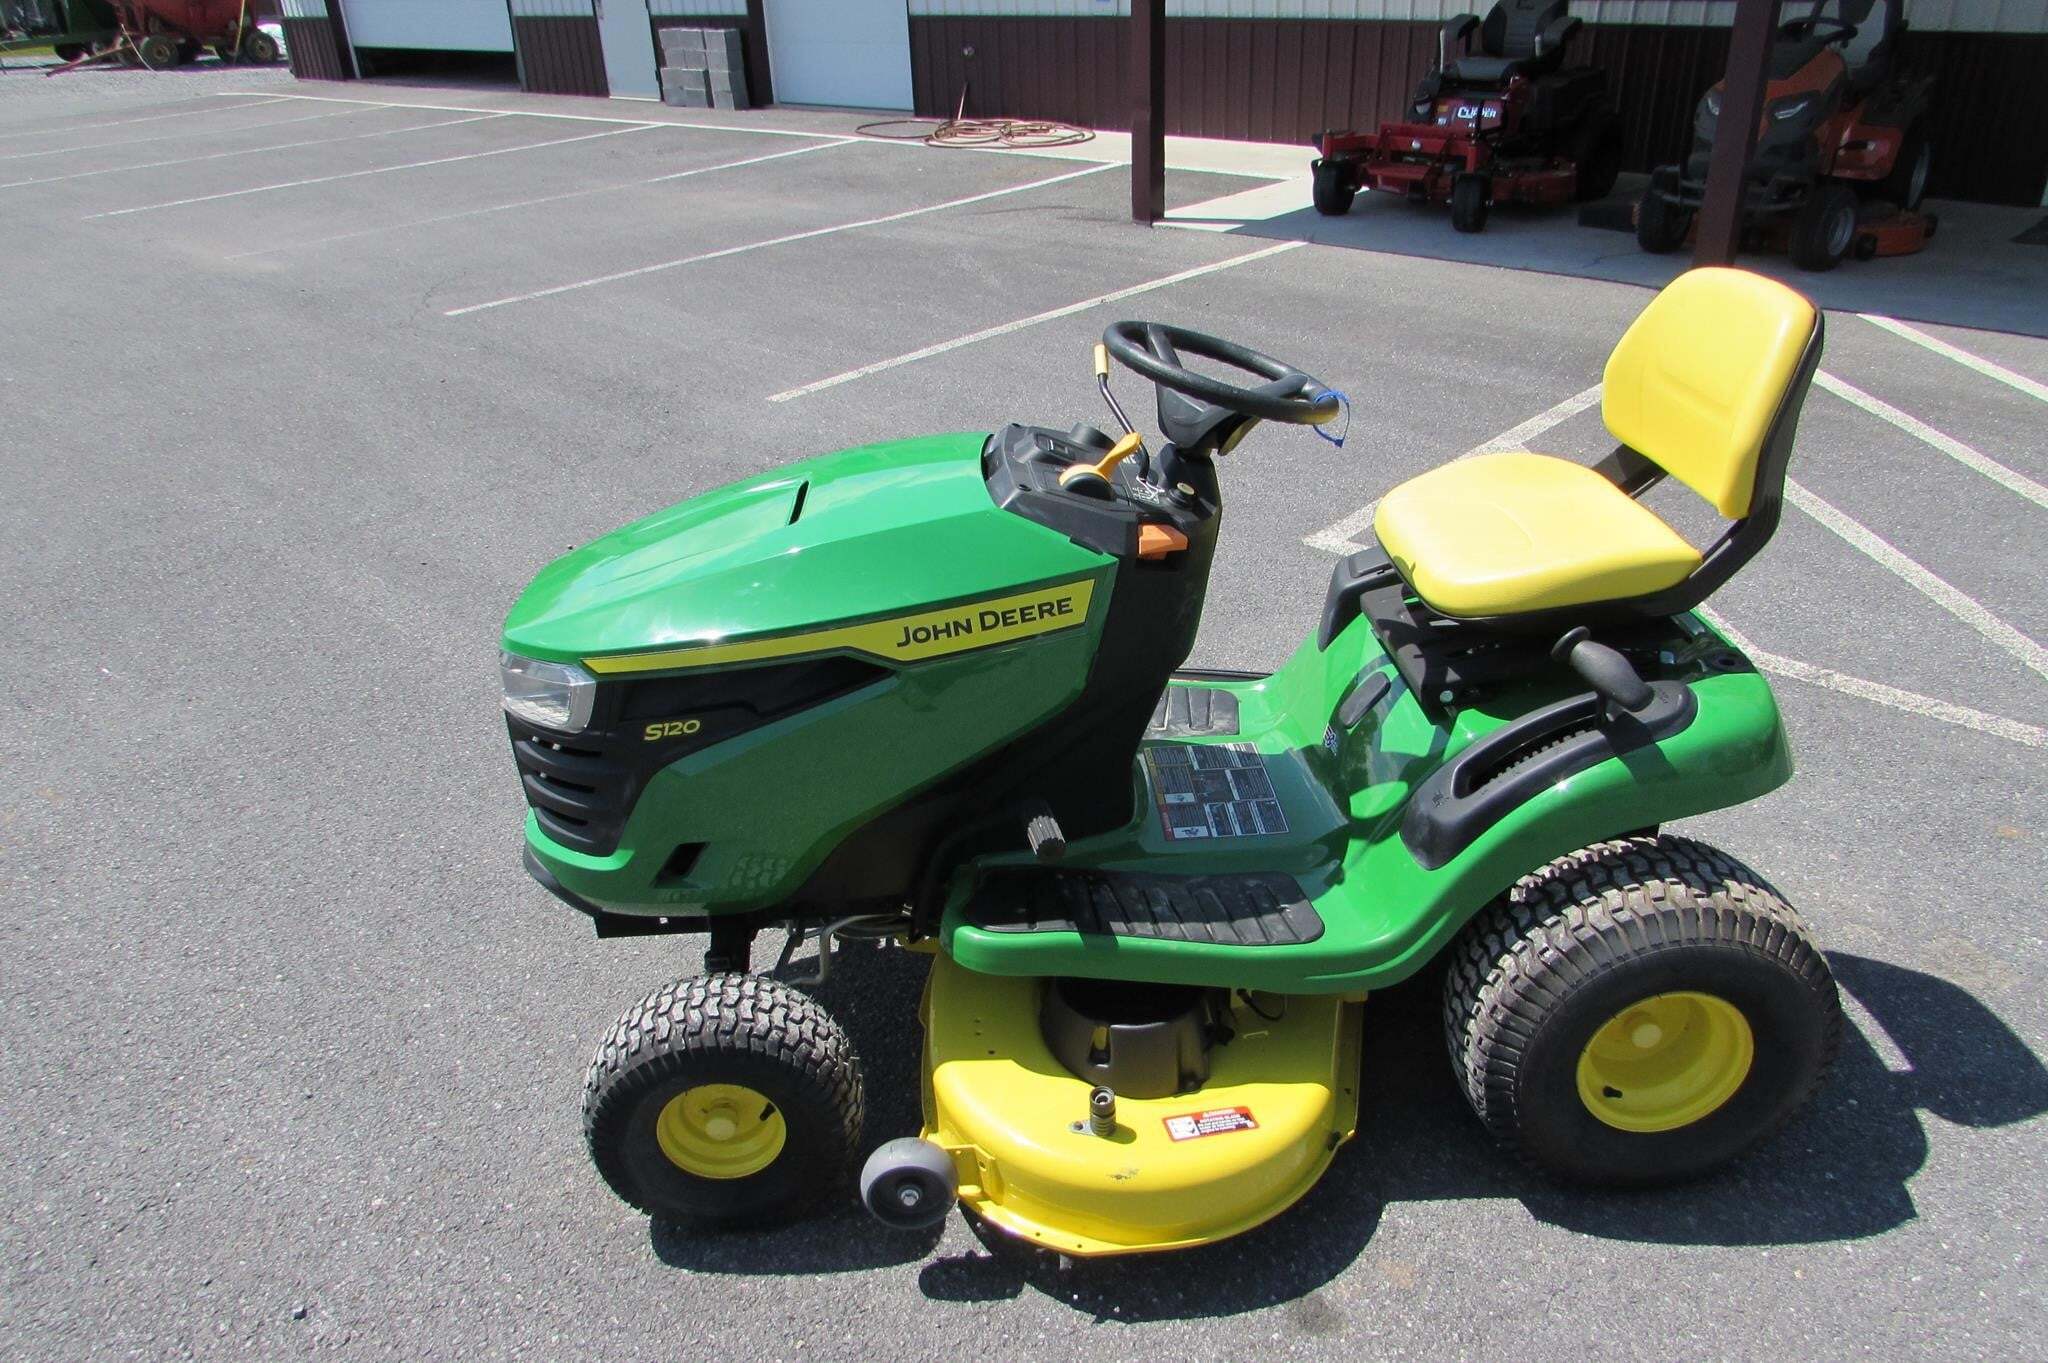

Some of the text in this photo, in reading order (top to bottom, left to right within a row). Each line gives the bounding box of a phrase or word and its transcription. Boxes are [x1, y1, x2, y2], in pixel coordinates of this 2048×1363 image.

[897, 597, 1074, 648] JOHN DEERE
[644, 719, 701, 741] S120
